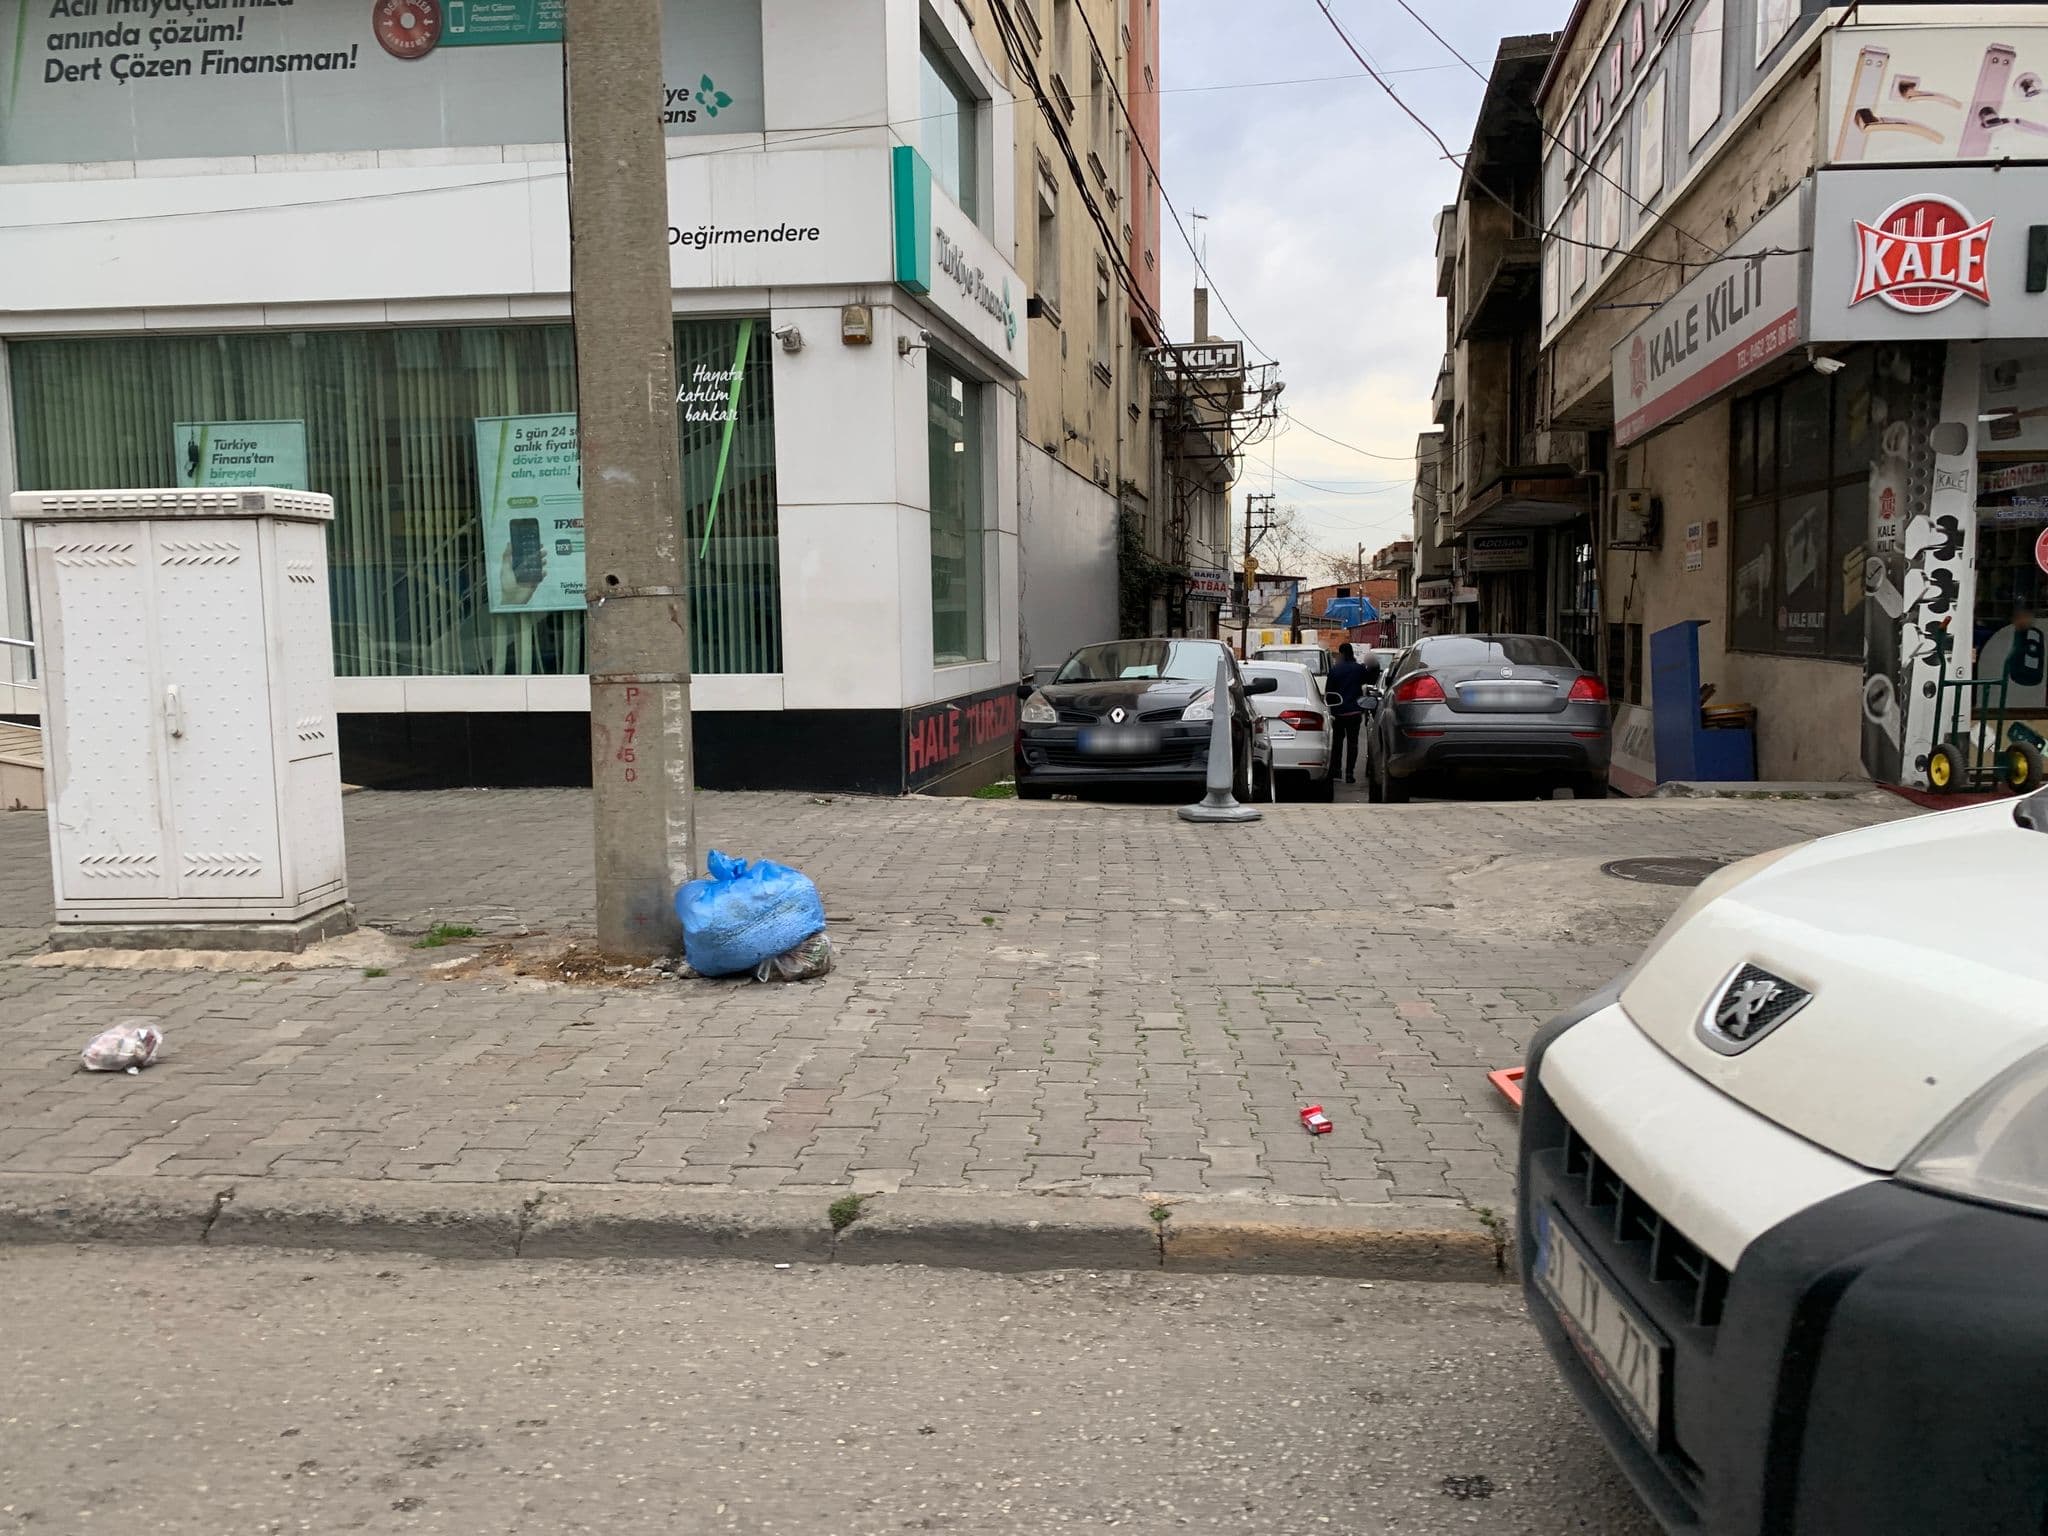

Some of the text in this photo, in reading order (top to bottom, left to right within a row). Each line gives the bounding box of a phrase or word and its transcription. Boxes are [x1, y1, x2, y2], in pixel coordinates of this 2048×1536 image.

[49, 0, 98, 18] Acil
[47, 16, 244, 51] anında çözüm!
[44, 44, 358, 85] Dert Çözen Finansman!
[668, 222, 820, 250] Değirmendere
[936, 226, 974, 299] Türkiye
[1860, 226, 1989, 296] KALE
[1650, 303, 1698, 381] KALE
[1706, 255, 1767, 343] KİLİT
[693, 363, 744, 390] Hayata
[676, 384, 730, 403] katılım
[515, 428, 522, 439] 5
[526, 427, 548, 441] gün
[552, 426, 566, 438] 24
[214, 439, 258, 454] Türkiye
[513, 437, 579, 453] anlık fiyatl
[211, 452, 275, 465] Finans'tan
[512, 452, 543, 466] döviz
[547, 454, 560, 464] ve
[209, 467, 257, 480] bireysel
[511, 464, 571, 480] alın, satın!
[1876, 525, 1896, 538] KALE
[909, 710, 959, 775] HALE
